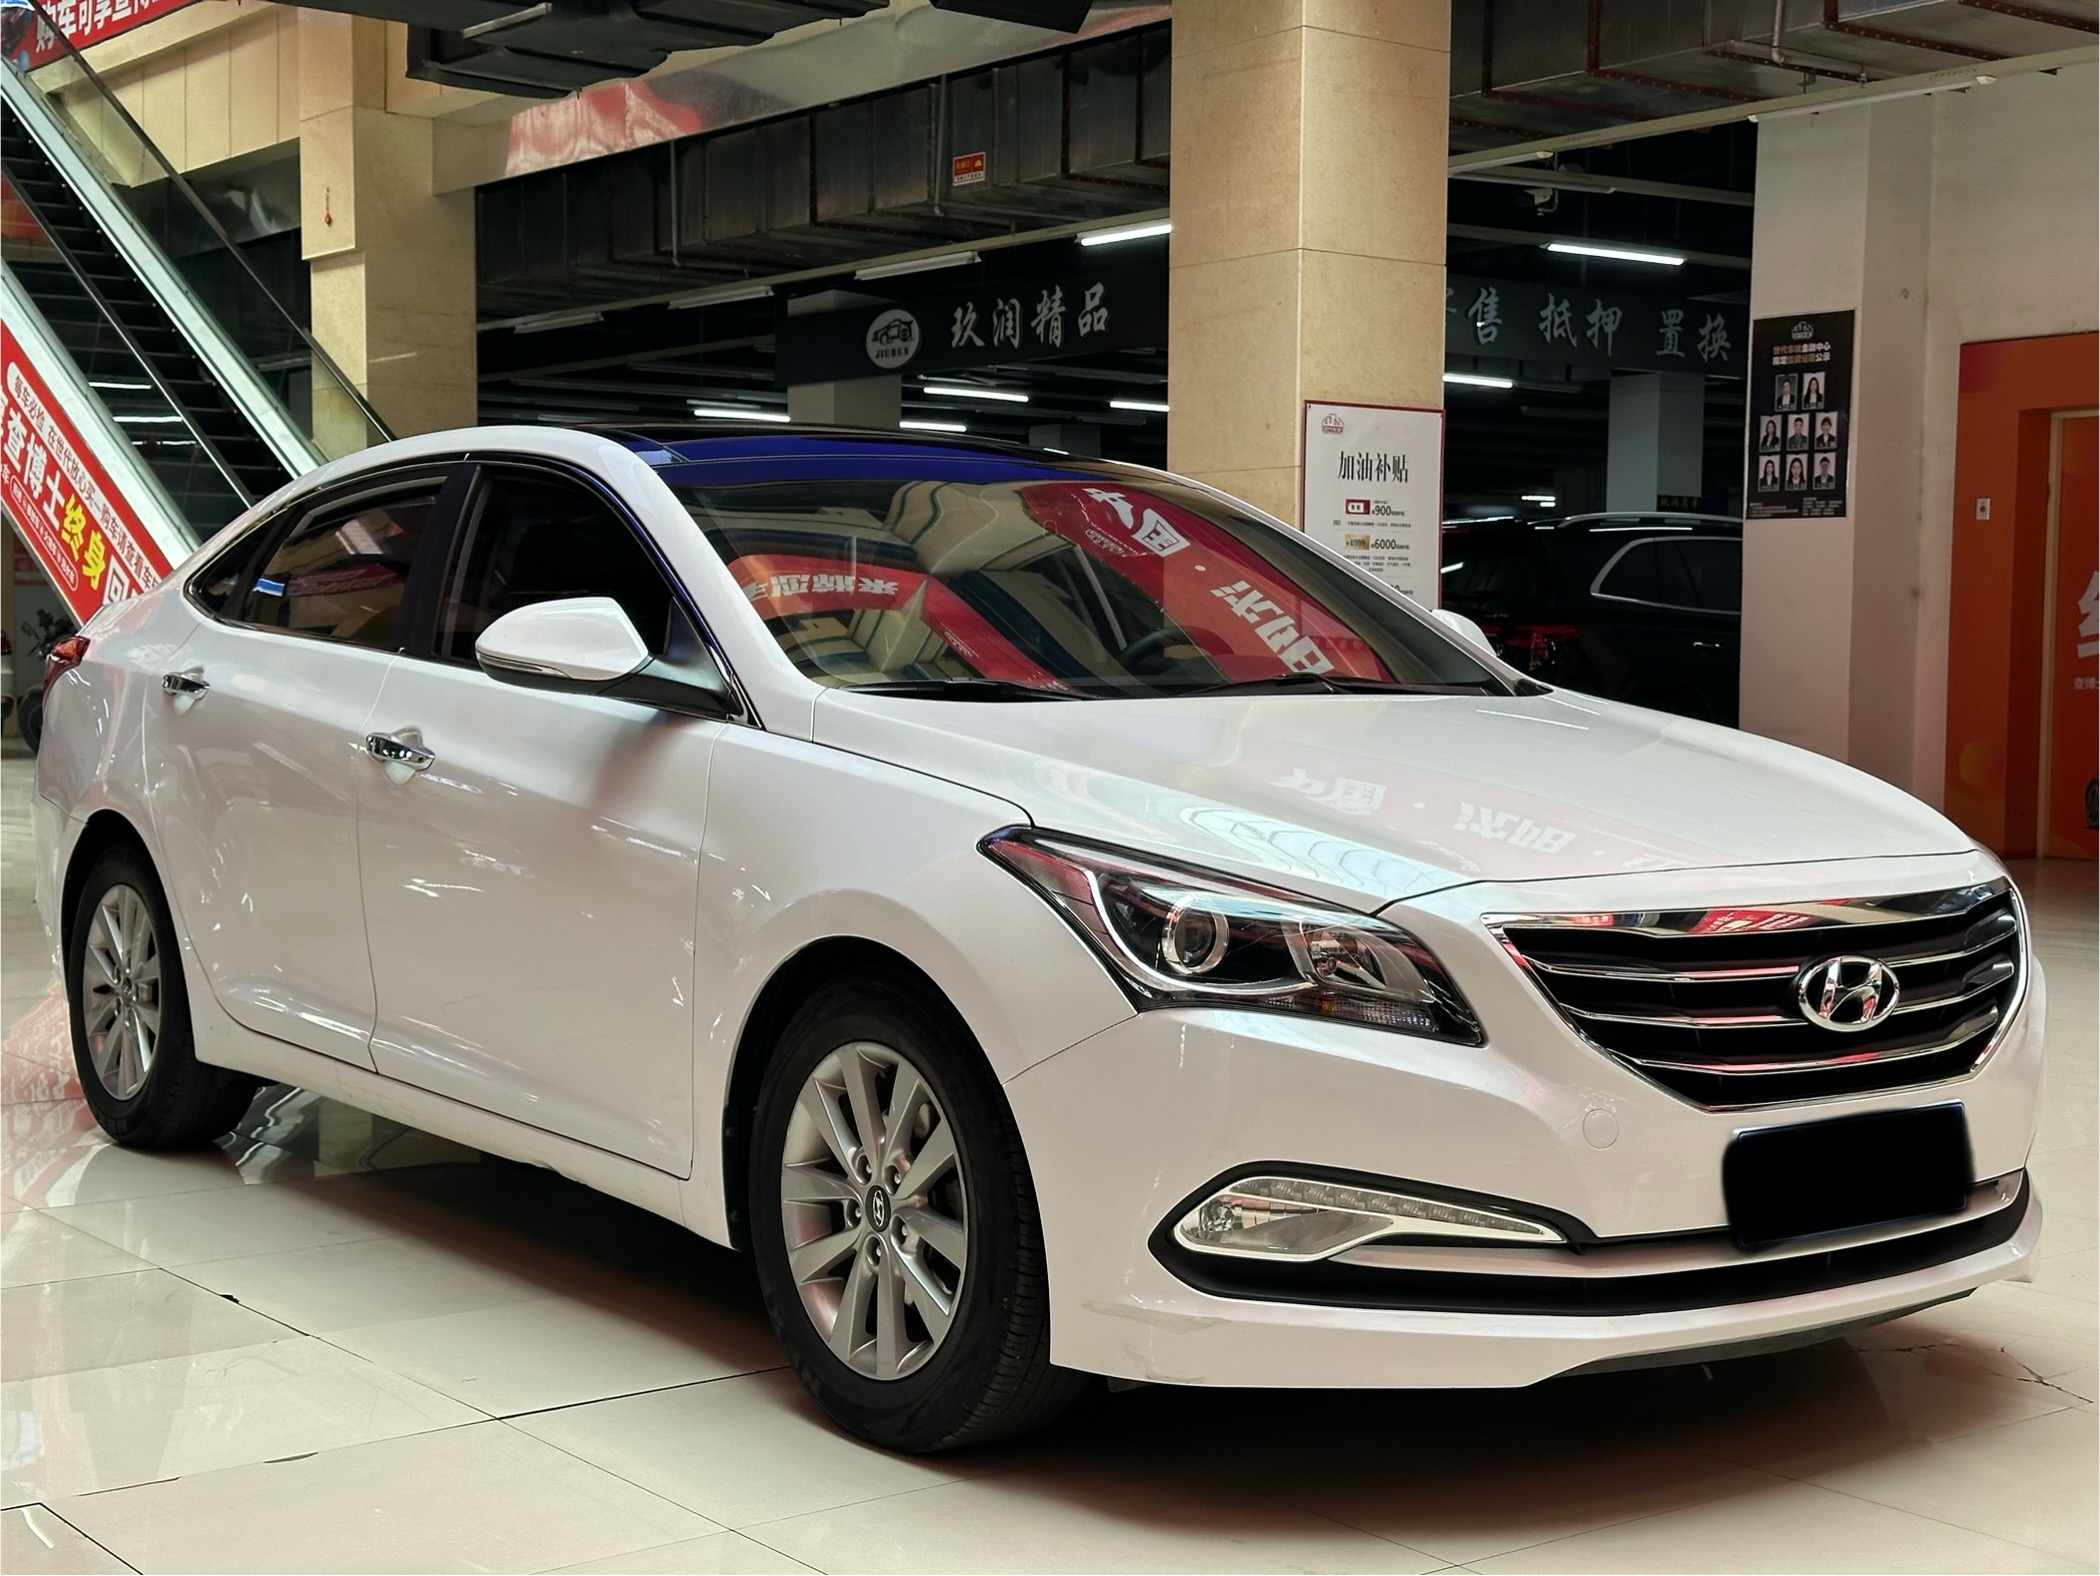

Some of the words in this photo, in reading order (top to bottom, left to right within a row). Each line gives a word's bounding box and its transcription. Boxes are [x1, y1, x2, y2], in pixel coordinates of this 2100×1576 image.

[951, 282, 1109, 349] 玖润精品
[1538, 293, 1623, 357] 抵押
[1656, 309, 1732, 363] 置换
[874, 346, 910, 359] JIURUN
[1338, 450, 1409, 484] 加油补贴
